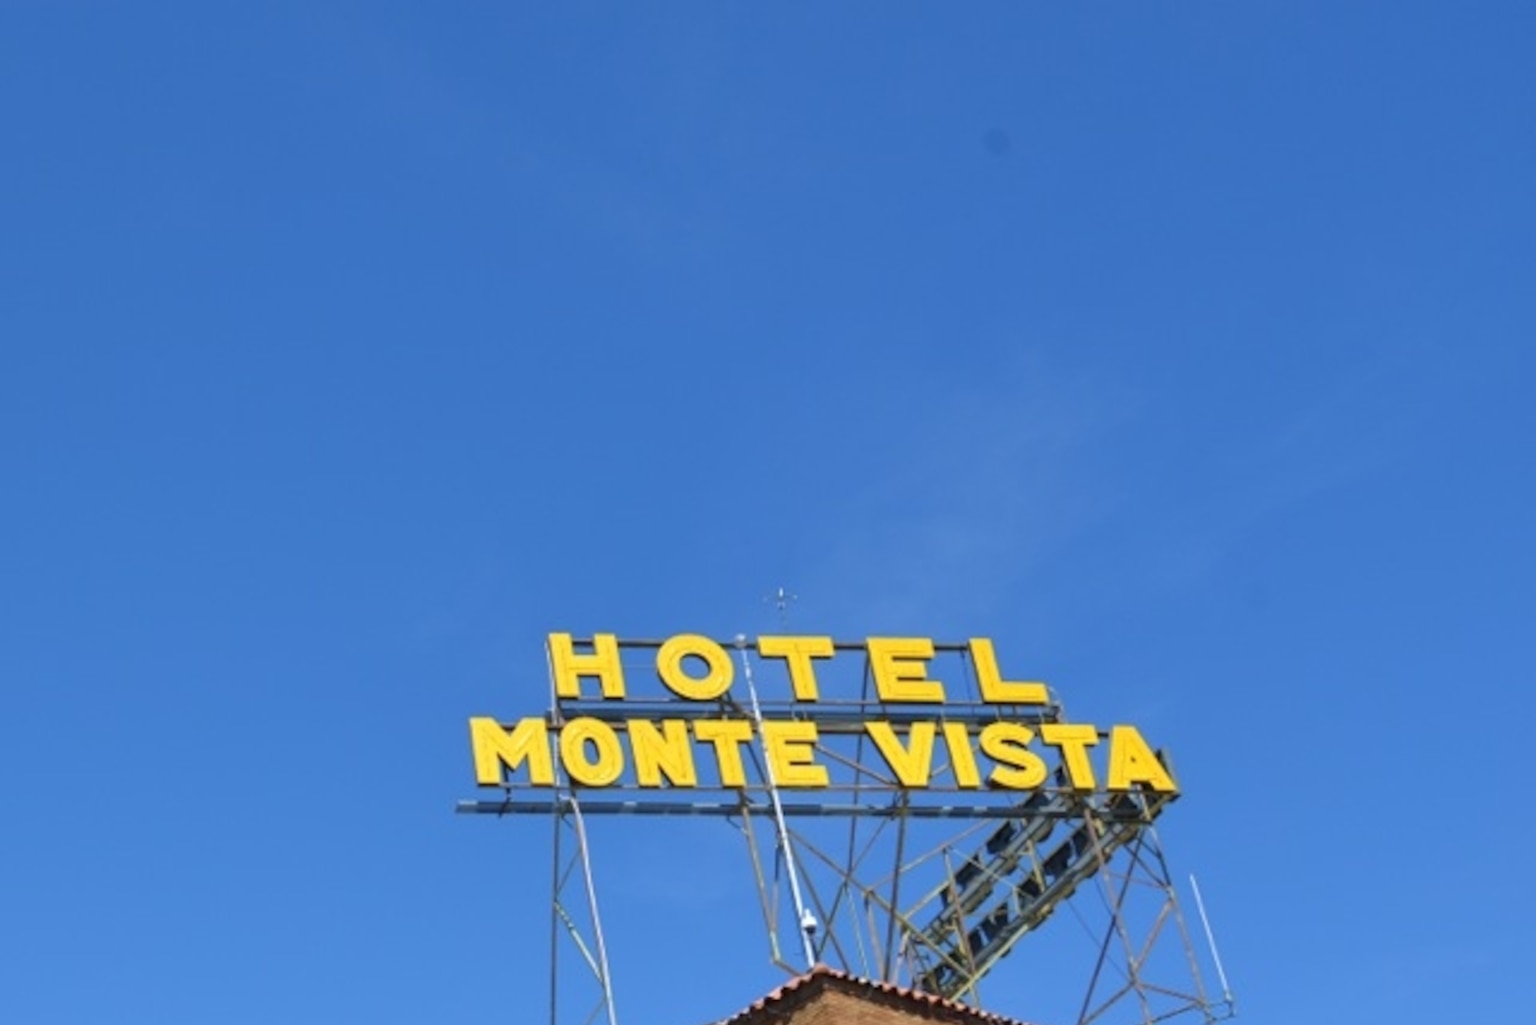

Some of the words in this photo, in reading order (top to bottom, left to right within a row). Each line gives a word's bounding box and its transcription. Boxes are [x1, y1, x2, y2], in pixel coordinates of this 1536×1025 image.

[547, 632, 1050, 706] HOTEL
[468, 716, 831, 789] MONTE
[865, 721, 1181, 794] VISTA
